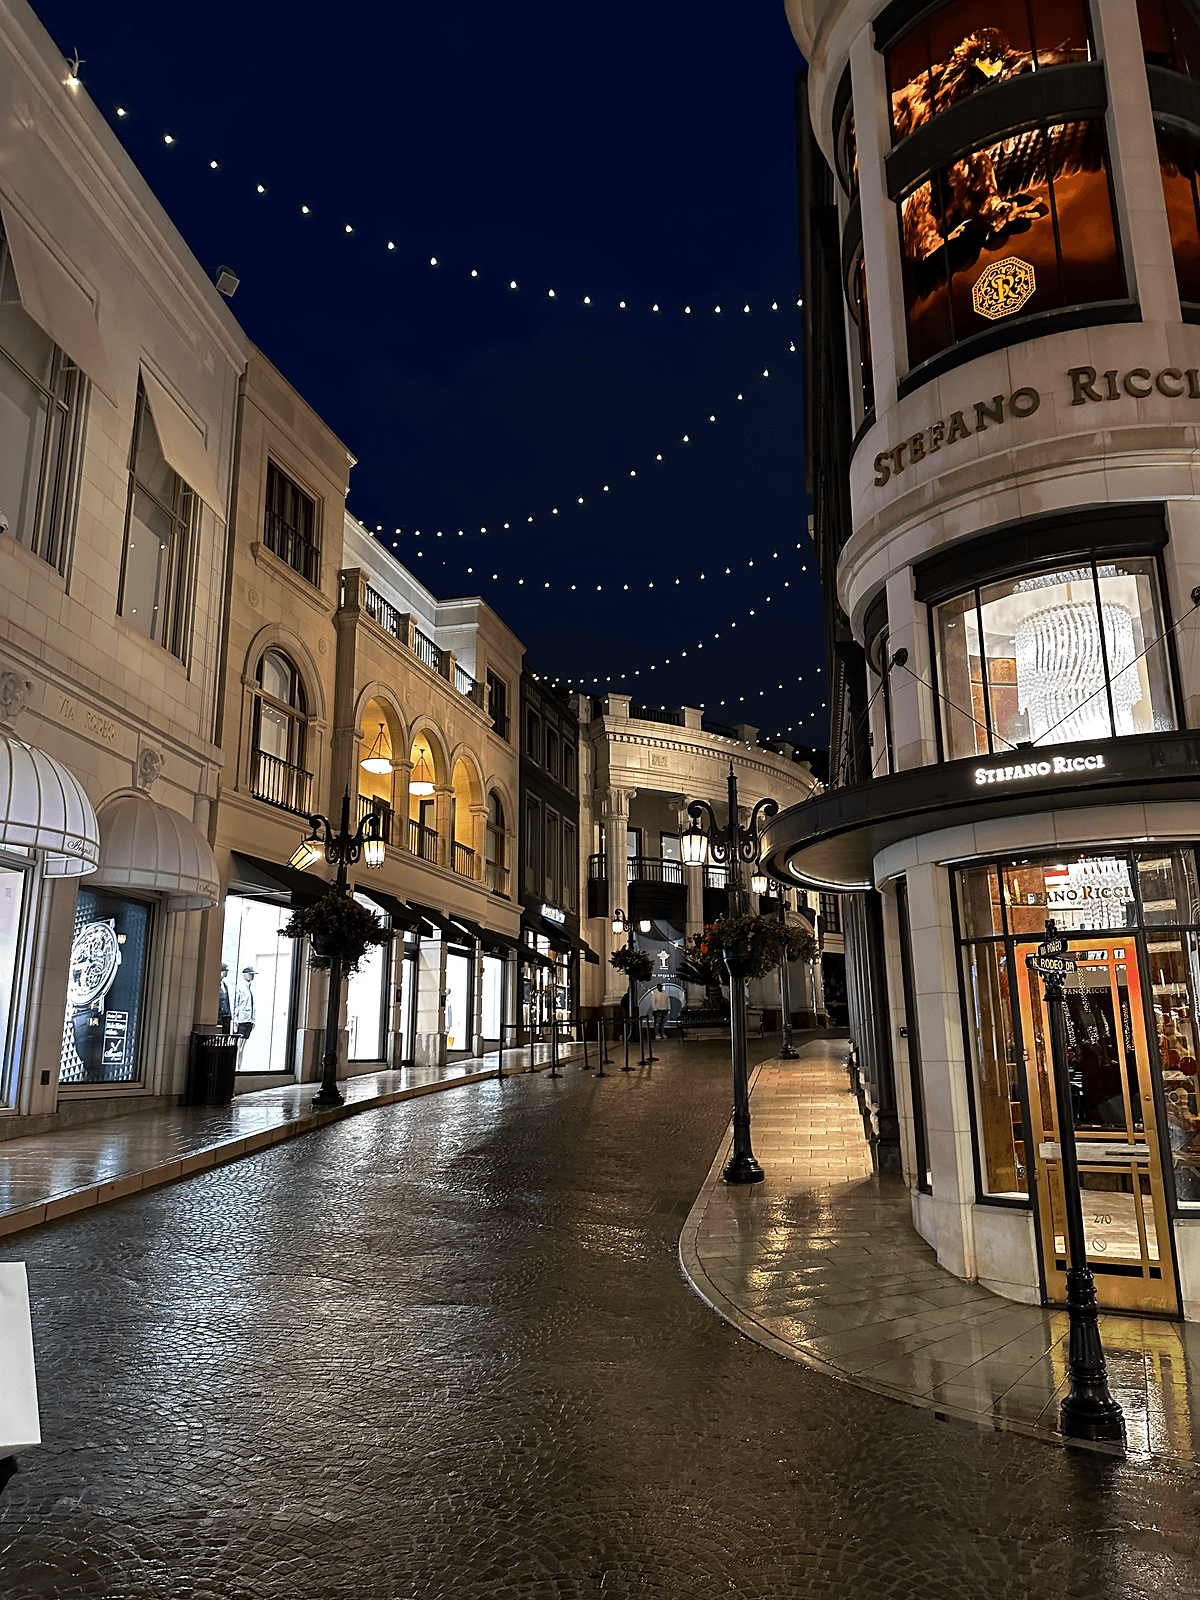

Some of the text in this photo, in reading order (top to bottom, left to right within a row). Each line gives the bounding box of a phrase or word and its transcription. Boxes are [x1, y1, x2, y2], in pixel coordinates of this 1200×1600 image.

[873, 365, 1200, 487] STEFANO RICCI
[58, 695, 116, 741] VIA RODEO
[975, 755, 1105, 785] STEFANO RICCI
[1010, 886, 1131, 905] STEFANO RICCI
[1047, 941, 1062, 953] RODEO
[1040, 958, 1063, 970] RODEO
[1065, 961, 1074, 971] DR
[1093, 1213, 1112, 1225] 270
